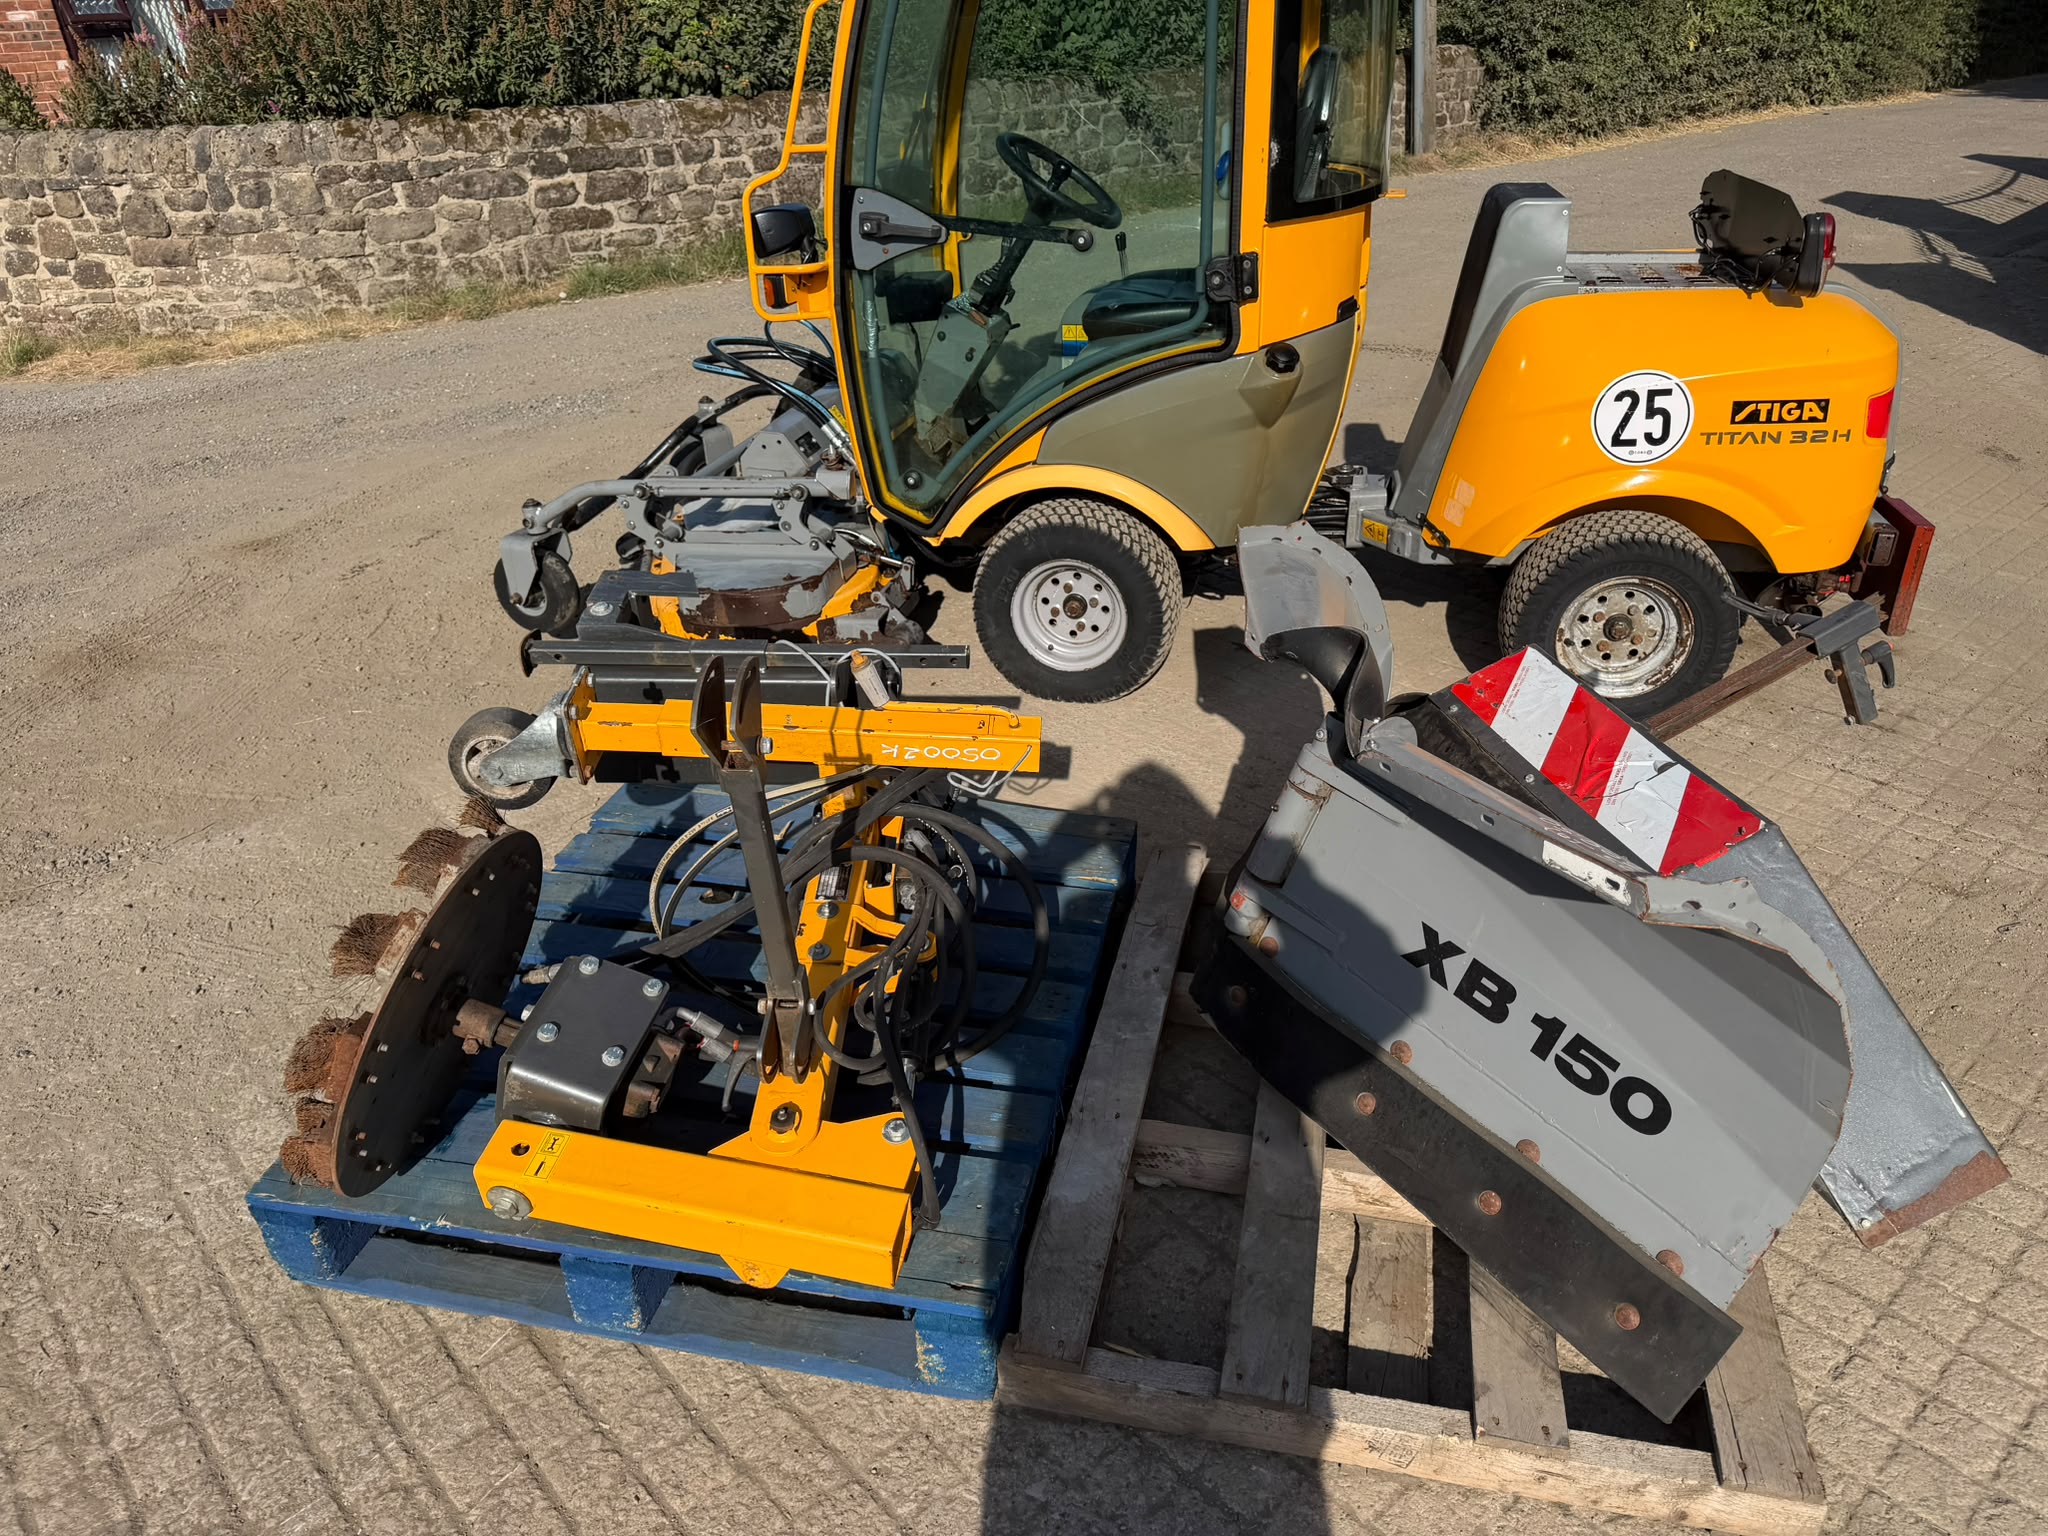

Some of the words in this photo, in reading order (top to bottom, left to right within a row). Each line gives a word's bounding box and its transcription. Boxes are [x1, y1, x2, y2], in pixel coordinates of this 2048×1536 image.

[1611, 388, 1674, 448] 25
[1734, 401, 1826, 423] STIGA
[1700, 430, 1782, 446] TITAN
[1400, 921, 1518, 1024] XB
[1529, 1012, 1673, 1136] 150
